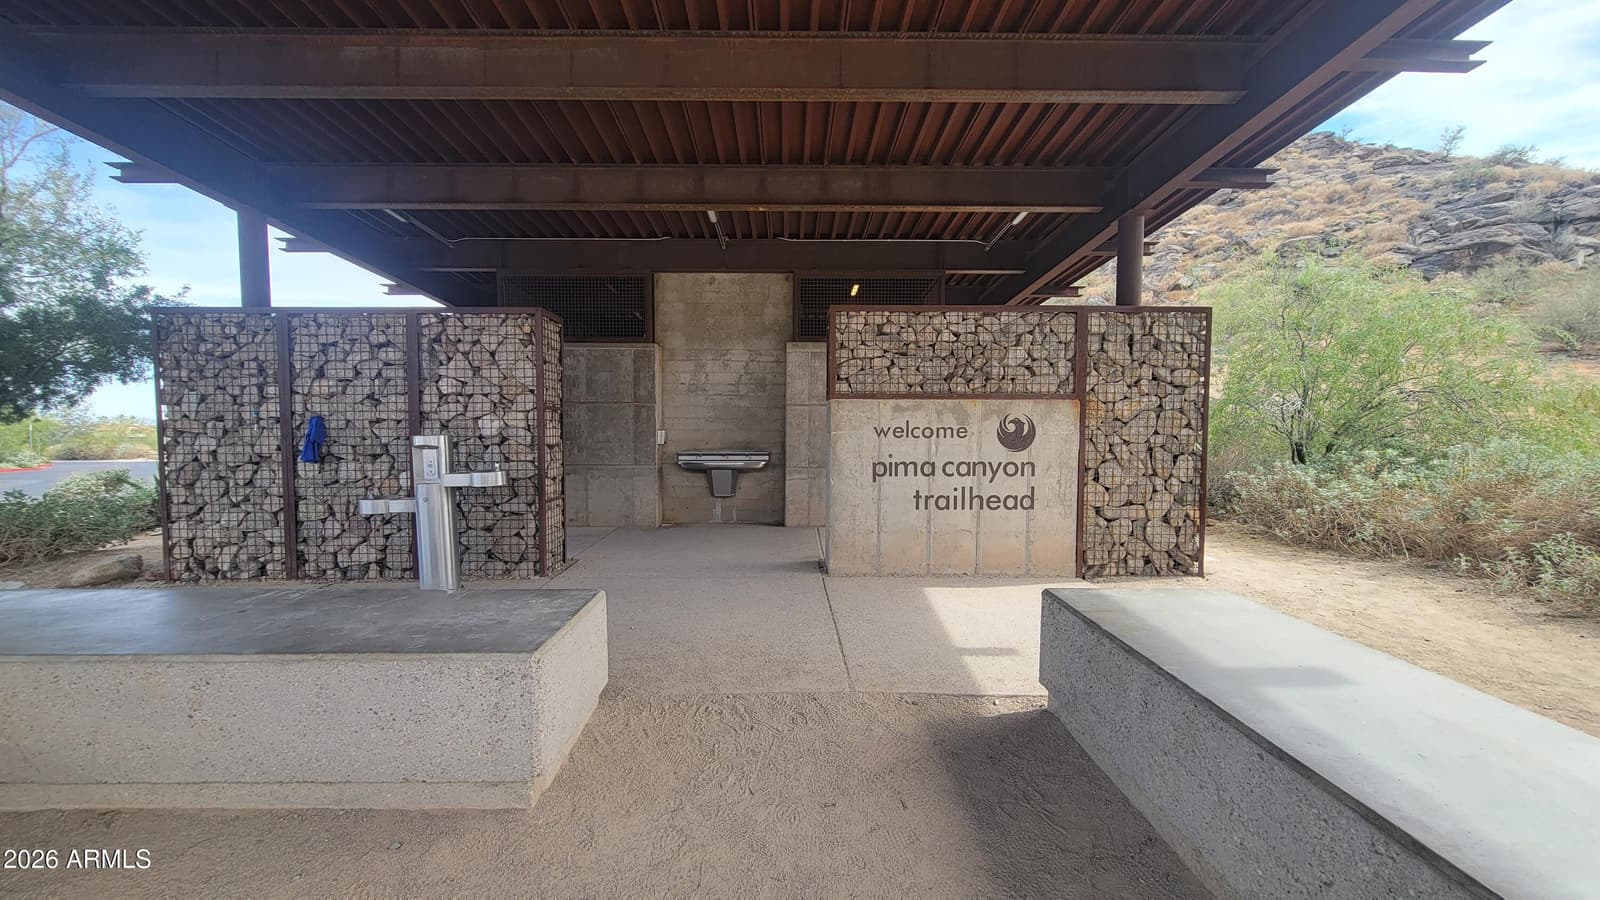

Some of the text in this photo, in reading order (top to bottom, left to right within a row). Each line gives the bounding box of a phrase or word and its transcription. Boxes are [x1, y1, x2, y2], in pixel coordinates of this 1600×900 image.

[873, 420, 968, 439] welcome
[872, 454, 1036, 483] pima canyon
[913, 486, 1035, 511] trailhead
